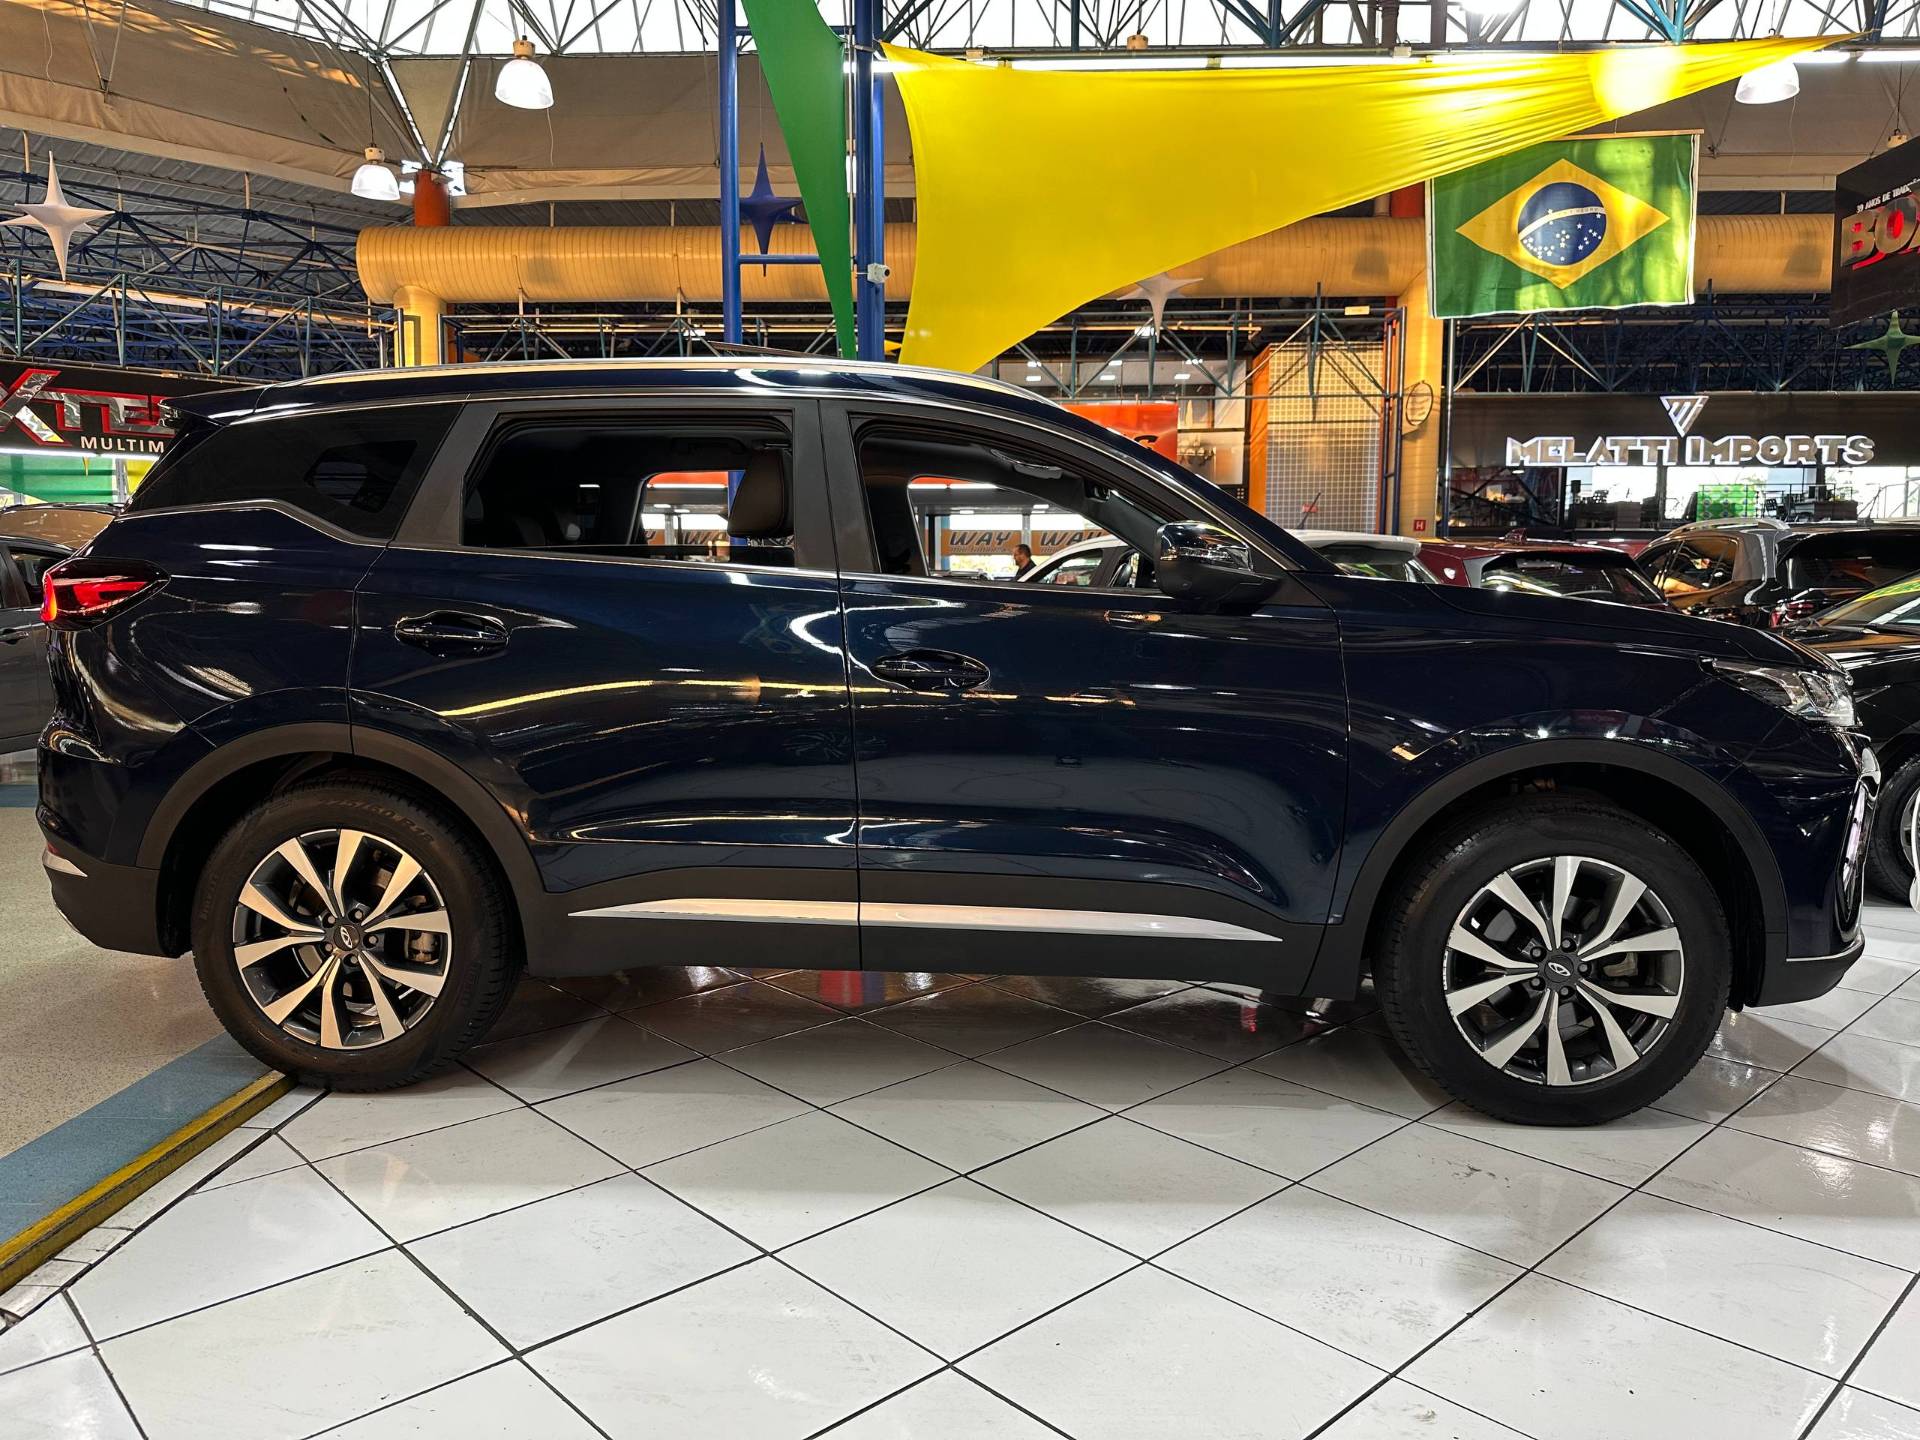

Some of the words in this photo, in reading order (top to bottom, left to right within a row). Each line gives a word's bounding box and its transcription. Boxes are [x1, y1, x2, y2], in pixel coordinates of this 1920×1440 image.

[1882, 191, 1891, 203] DE
[1841, 193, 1920, 269] BO
[1506, 436, 1679, 466] MELATTI
[1685, 435, 1875, 466] IMPORTS
[950, 531, 1011, 546] WAY
